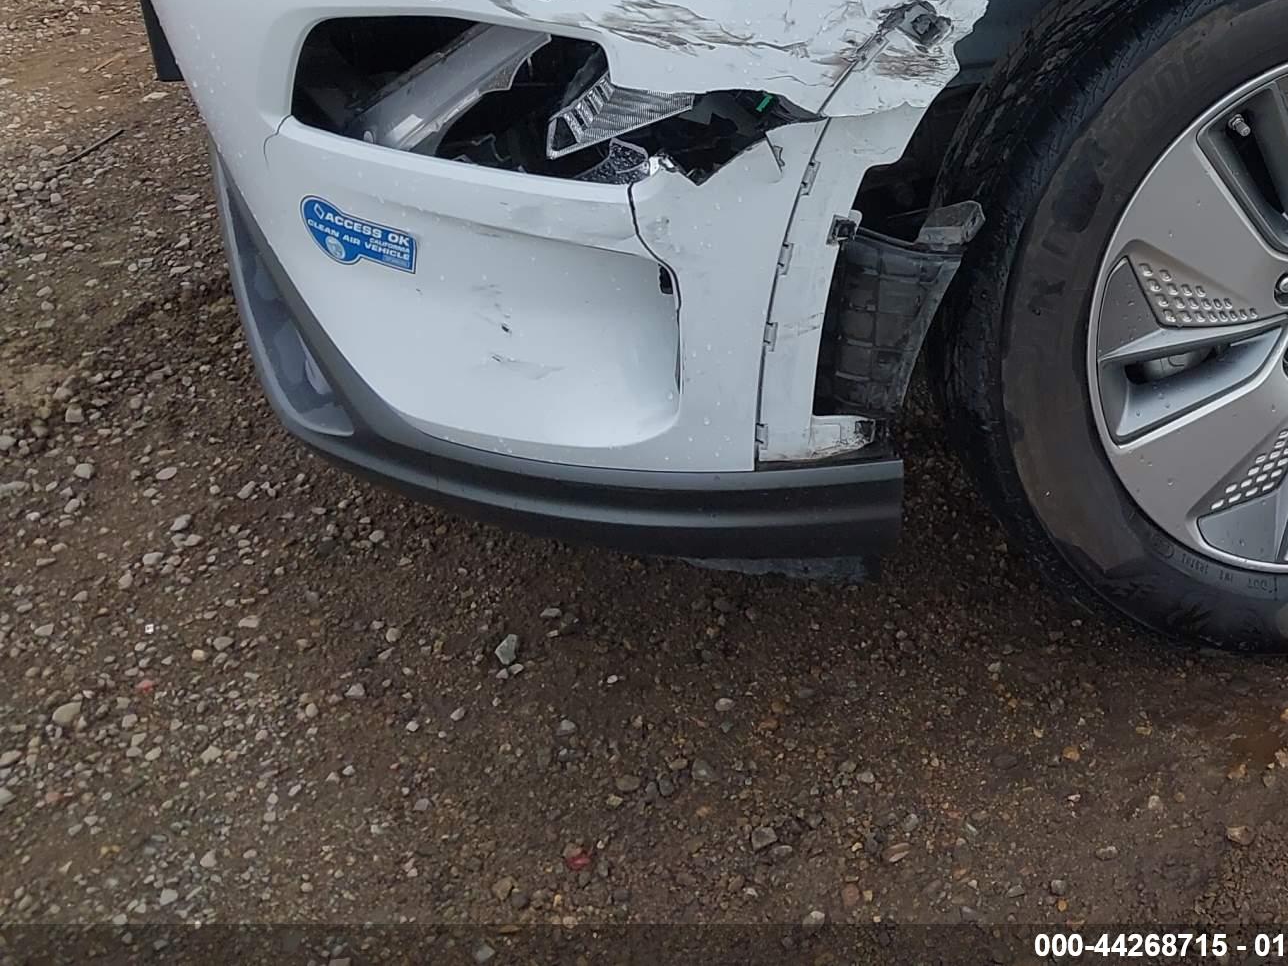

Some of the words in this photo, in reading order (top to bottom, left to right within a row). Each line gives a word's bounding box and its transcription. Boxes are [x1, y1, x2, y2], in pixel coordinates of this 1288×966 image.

[307, 218, 340, 237] CLEAN
[343, 234, 361, 246] AIR
[364, 241, 410, 261] VEHICLE
[325, 212, 382, 239] ACCESS
[387, 232, 410, 246] OK
